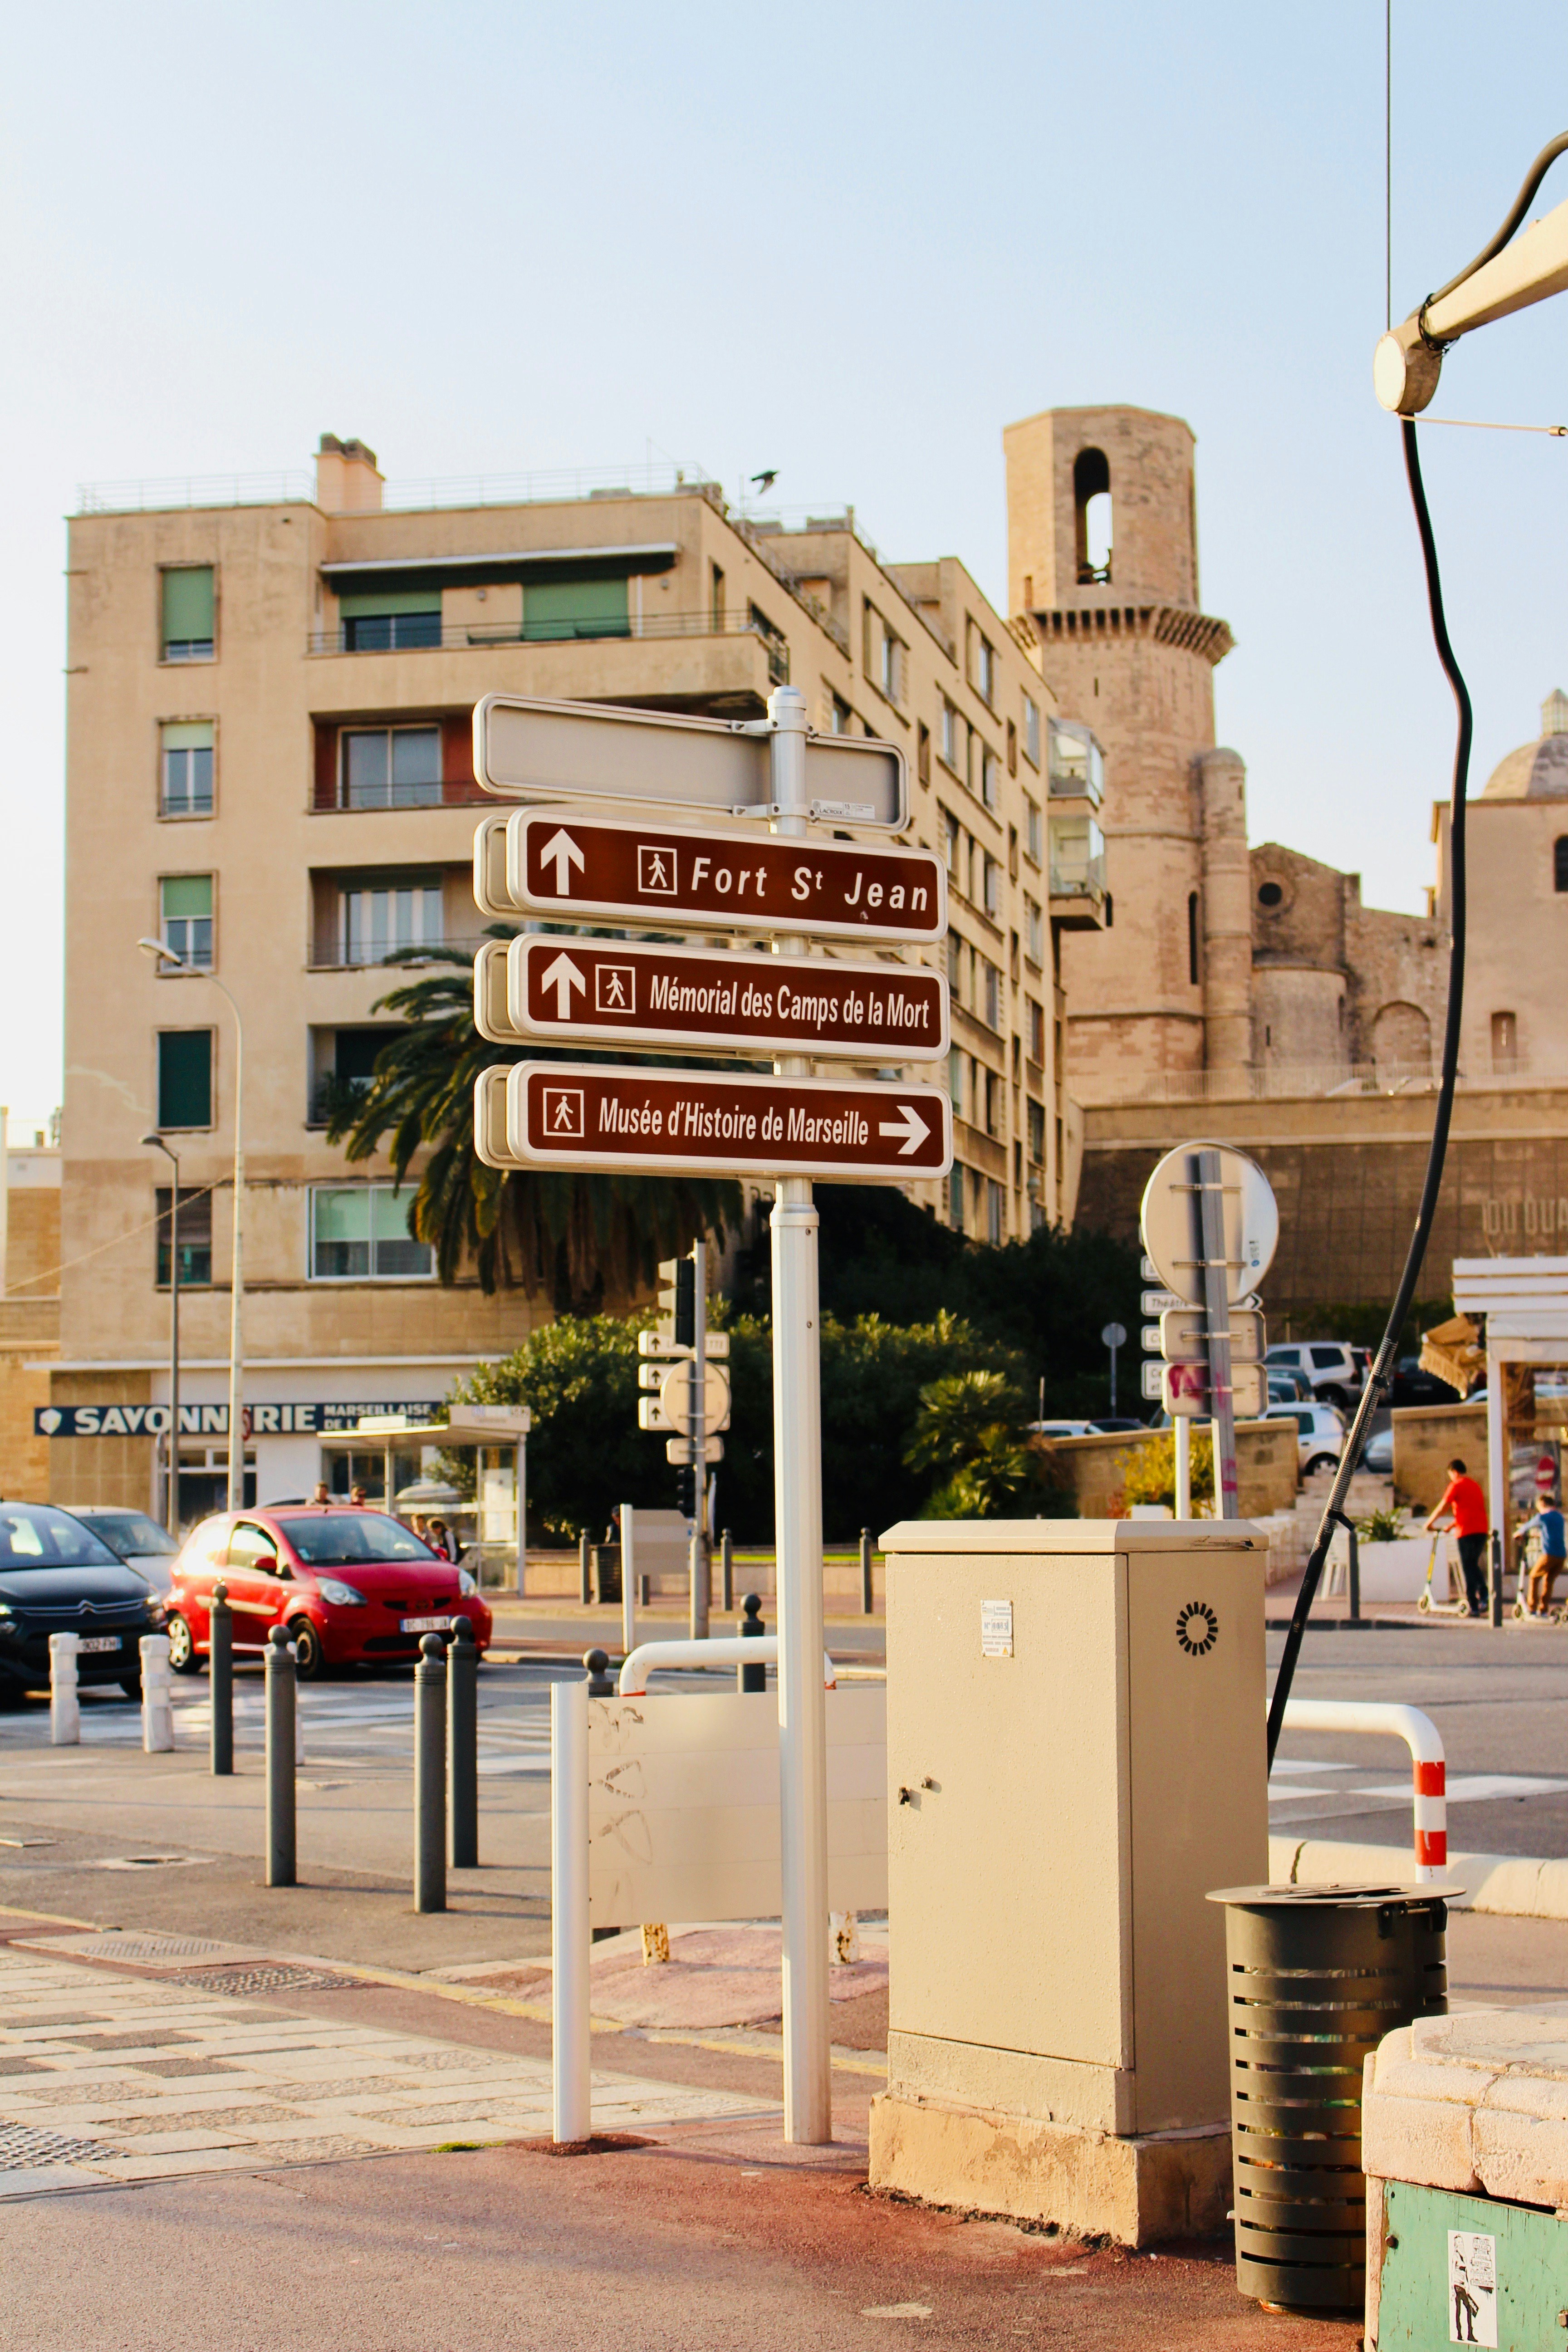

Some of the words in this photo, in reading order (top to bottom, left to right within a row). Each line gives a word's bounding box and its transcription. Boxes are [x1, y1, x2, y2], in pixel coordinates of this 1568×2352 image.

[691, 857, 767, 897] Fort
[791, 867, 823, 901] St
[844, 872, 927, 911] Jean
[650, 975, 738, 1015] Mémorial
[741, 983, 773, 1018] des
[777, 985, 838, 1030] Camps
[843, 990, 863, 1024] de
[868, 991, 883, 1025] la
[887, 993, 929, 1029] Mort
[598, 1097, 662, 1135] Musée
[667, 1101, 756, 1140] d'Histoire
[761, 1107, 783, 1141] de
[787, 1107, 868, 1145] Marseille
[74, 1405, 316, 1435] SAVONNRIE
[323, 1403, 430, 1417] MARSEILLAISE
[324, 1418, 342, 1430] DE
